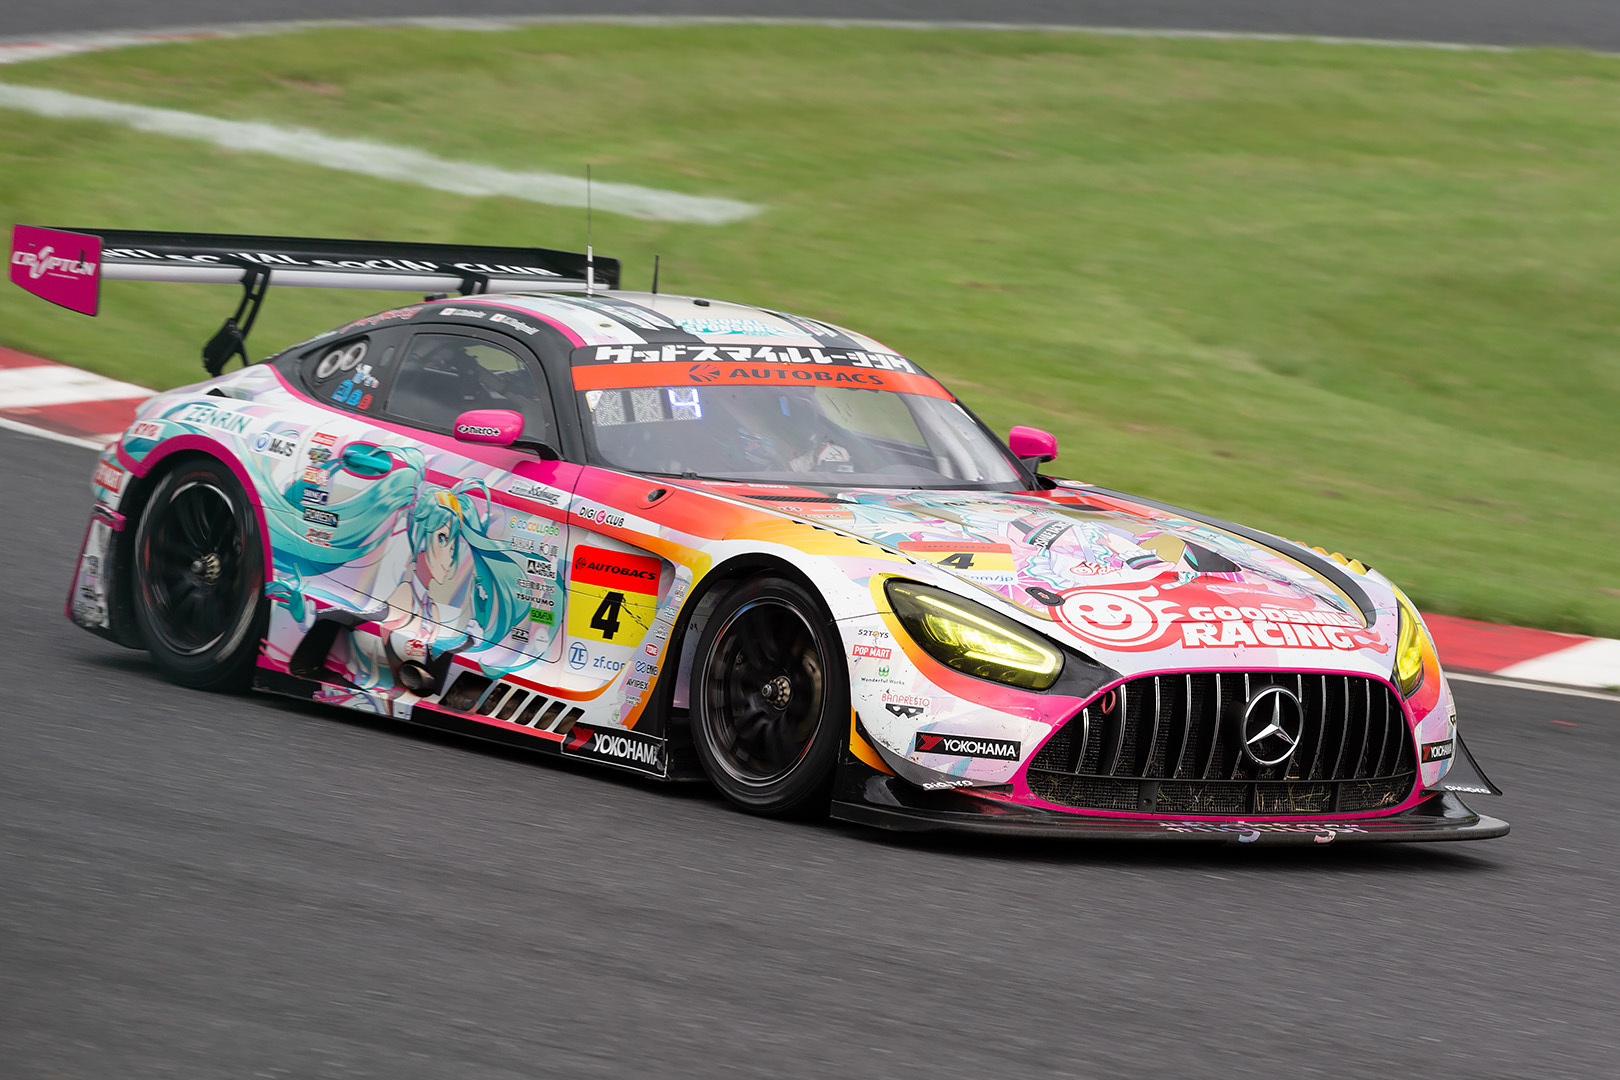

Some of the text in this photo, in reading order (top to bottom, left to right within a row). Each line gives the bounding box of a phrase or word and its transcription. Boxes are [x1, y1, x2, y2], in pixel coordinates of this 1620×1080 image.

[595, 344, 917, 375] グッドスマイルレーシング
[728, 367, 884, 386] AUTOBACS
[668, 386, 703, 419] 4
[184, 405, 254, 434] ZENRIN
[605, 514, 625, 527] CLUB
[937, 552, 975, 570] 4
[586, 562, 657, 581] AUTOBACS
[516, 592, 555, 607] TSUKUMO
[590, 591, 625, 640] 4
[1187, 606, 1366, 628] GOODSMILE
[1181, 620, 1355, 648] RACING
[570, 646, 588, 665] ZF
[854, 645, 891, 658] POP MART
[881, 693, 931, 707] BANPRESTO
[943, 738, 1017, 758] YOKOHAMA
